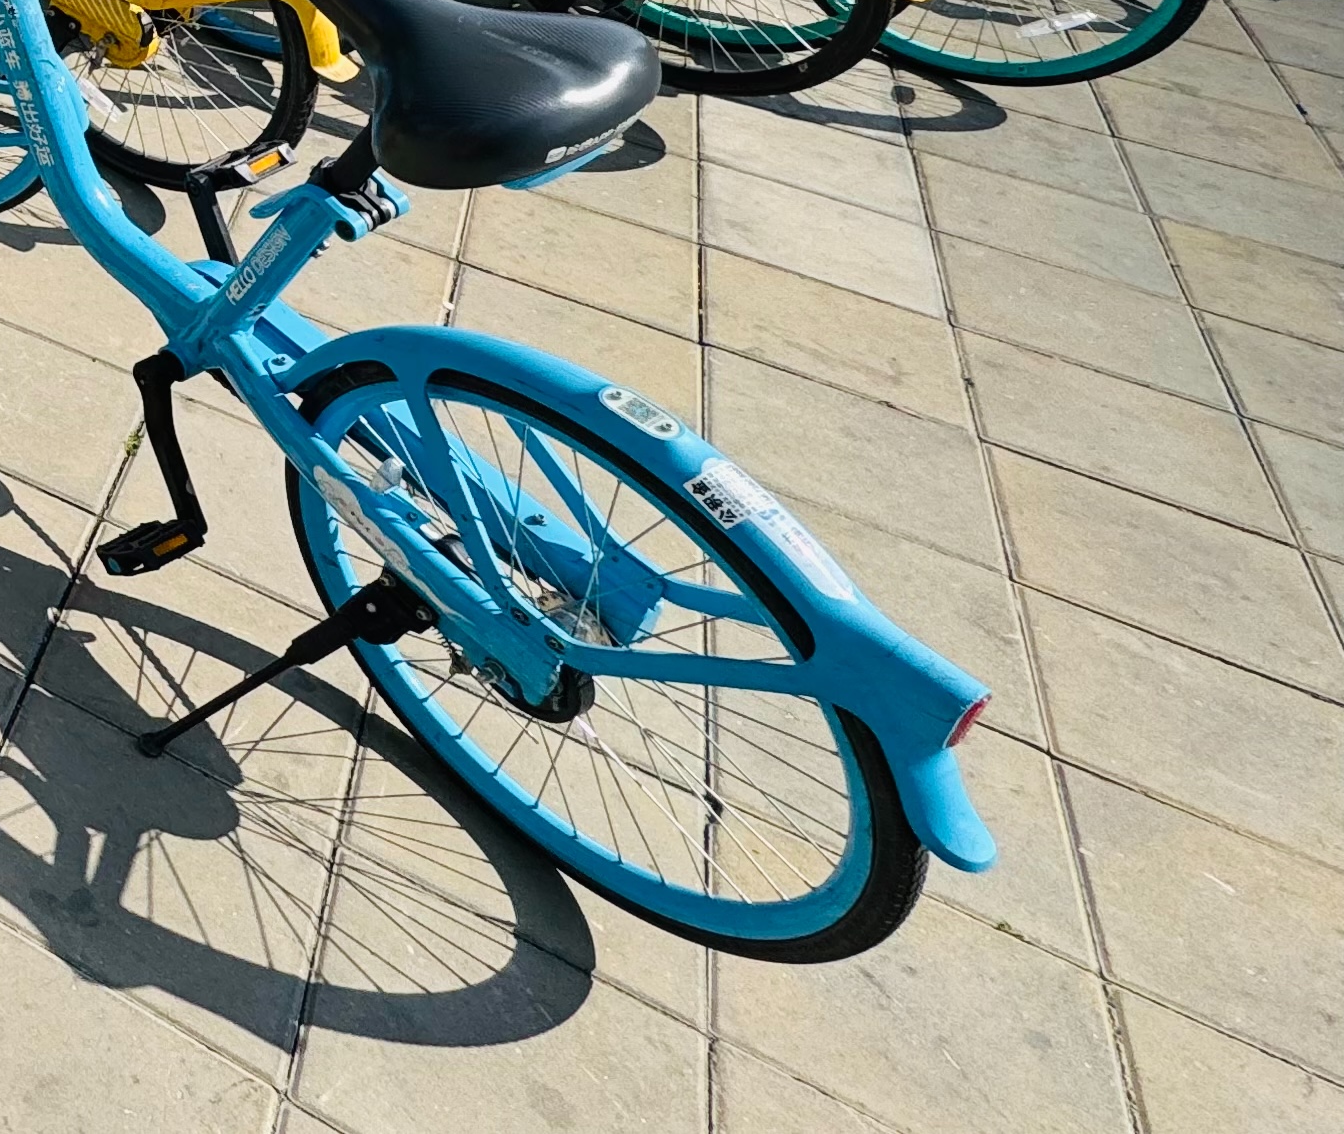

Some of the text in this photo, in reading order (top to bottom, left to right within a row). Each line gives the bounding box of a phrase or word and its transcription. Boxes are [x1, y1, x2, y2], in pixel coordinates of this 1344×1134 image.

[12, 79, 55, 167] 骑出好运
[225, 223, 292, 306] HELLO DESIGN
[691, 479, 738, 523] 公积金
